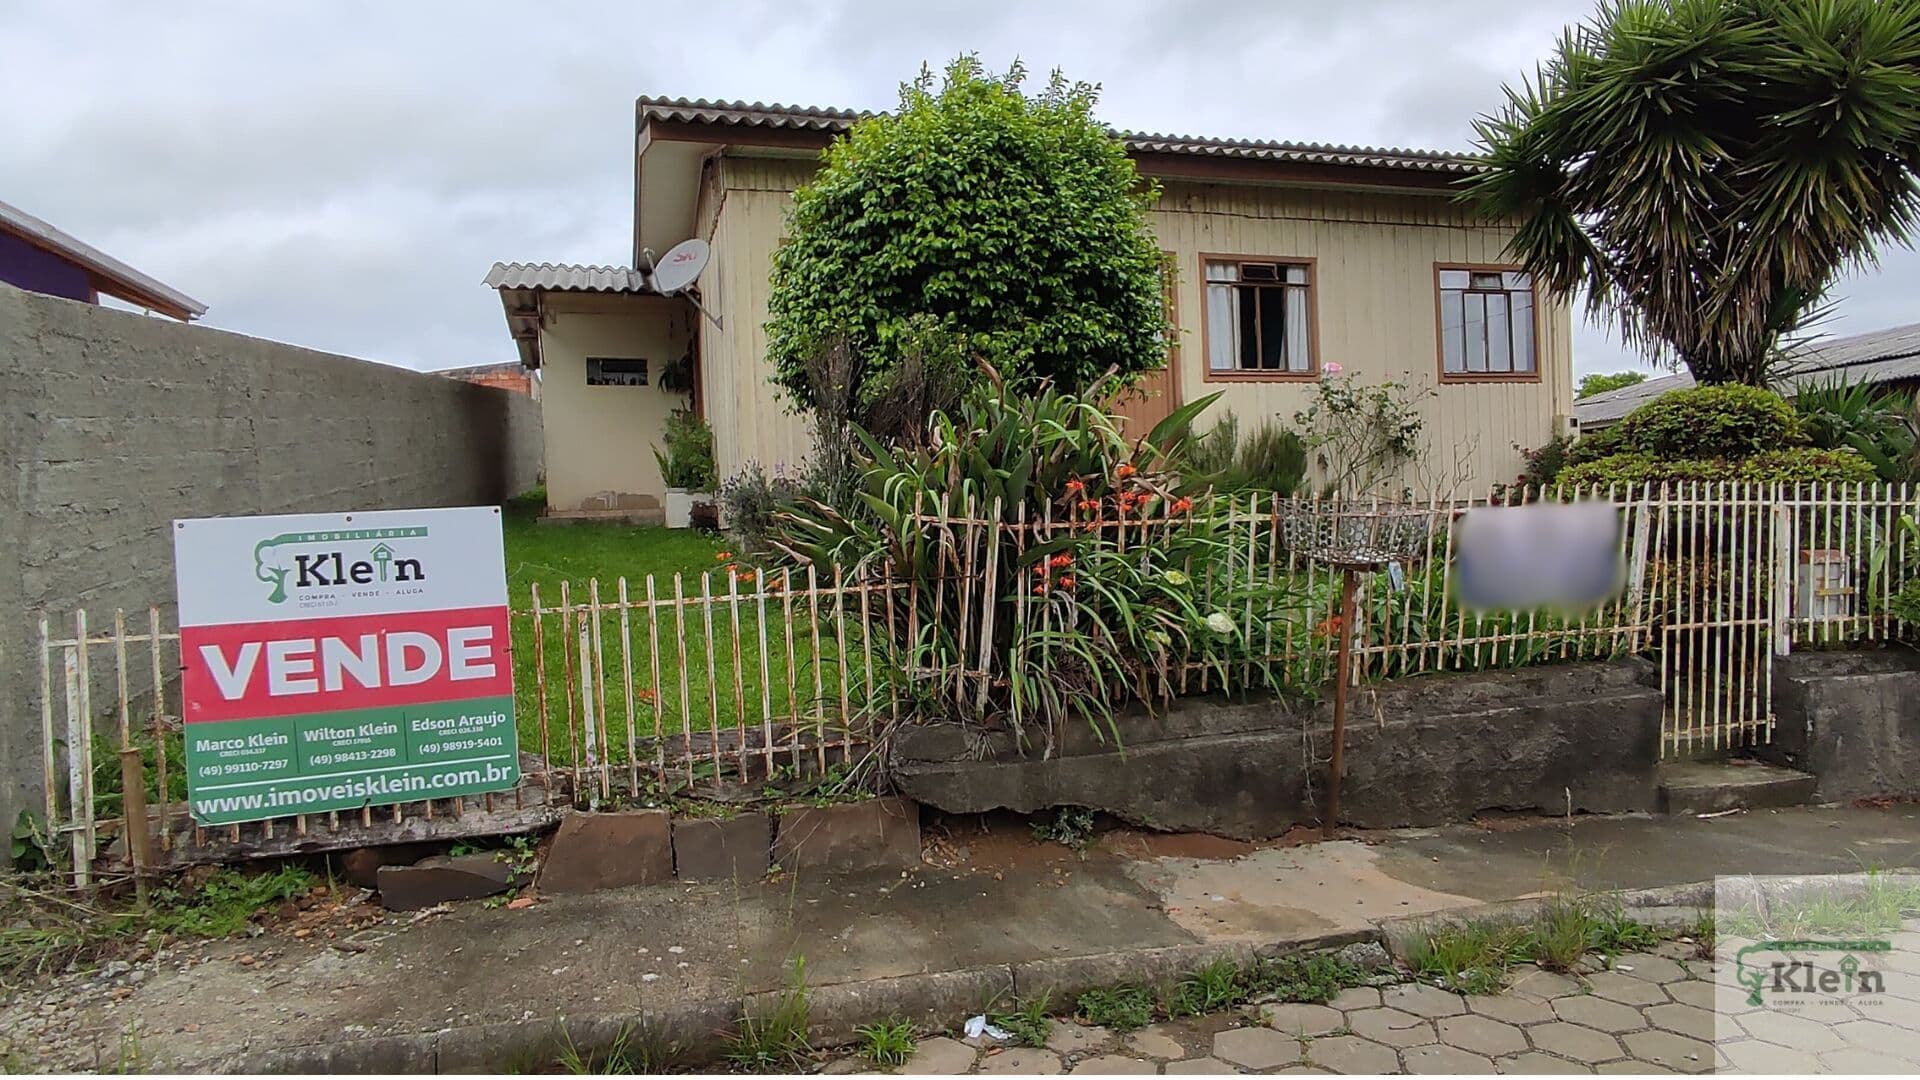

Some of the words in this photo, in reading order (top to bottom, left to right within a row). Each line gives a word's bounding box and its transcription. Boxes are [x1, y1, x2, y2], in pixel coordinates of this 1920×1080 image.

[298, 529, 418, 542] IMOBILIÁRIA
[294, 543, 426, 588] Klein
[298, 593, 336, 602] COMPRA
[352, 590, 380, 598] VENDE
[199, 625, 497, 701] VENDE
[412, 718, 455, 732] Edson
[458, 711, 506, 728] Araujo
[196, 738, 244, 752] Marco
[248, 732, 288, 748] Klein
[304, 727, 356, 743] Wilton
[359, 722, 398, 737] Klein
[419, 743, 440, 755] (49)
[442, 737, 503, 751] 98919-5401
[310, 754, 332, 766] (49)
[334, 747, 397, 763] 98413-2298
[199, 765, 222, 778] (49)
[224, 758, 289, 774] 99110-7297
[196, 762, 512, 815] www.imoveisklein.com.br
